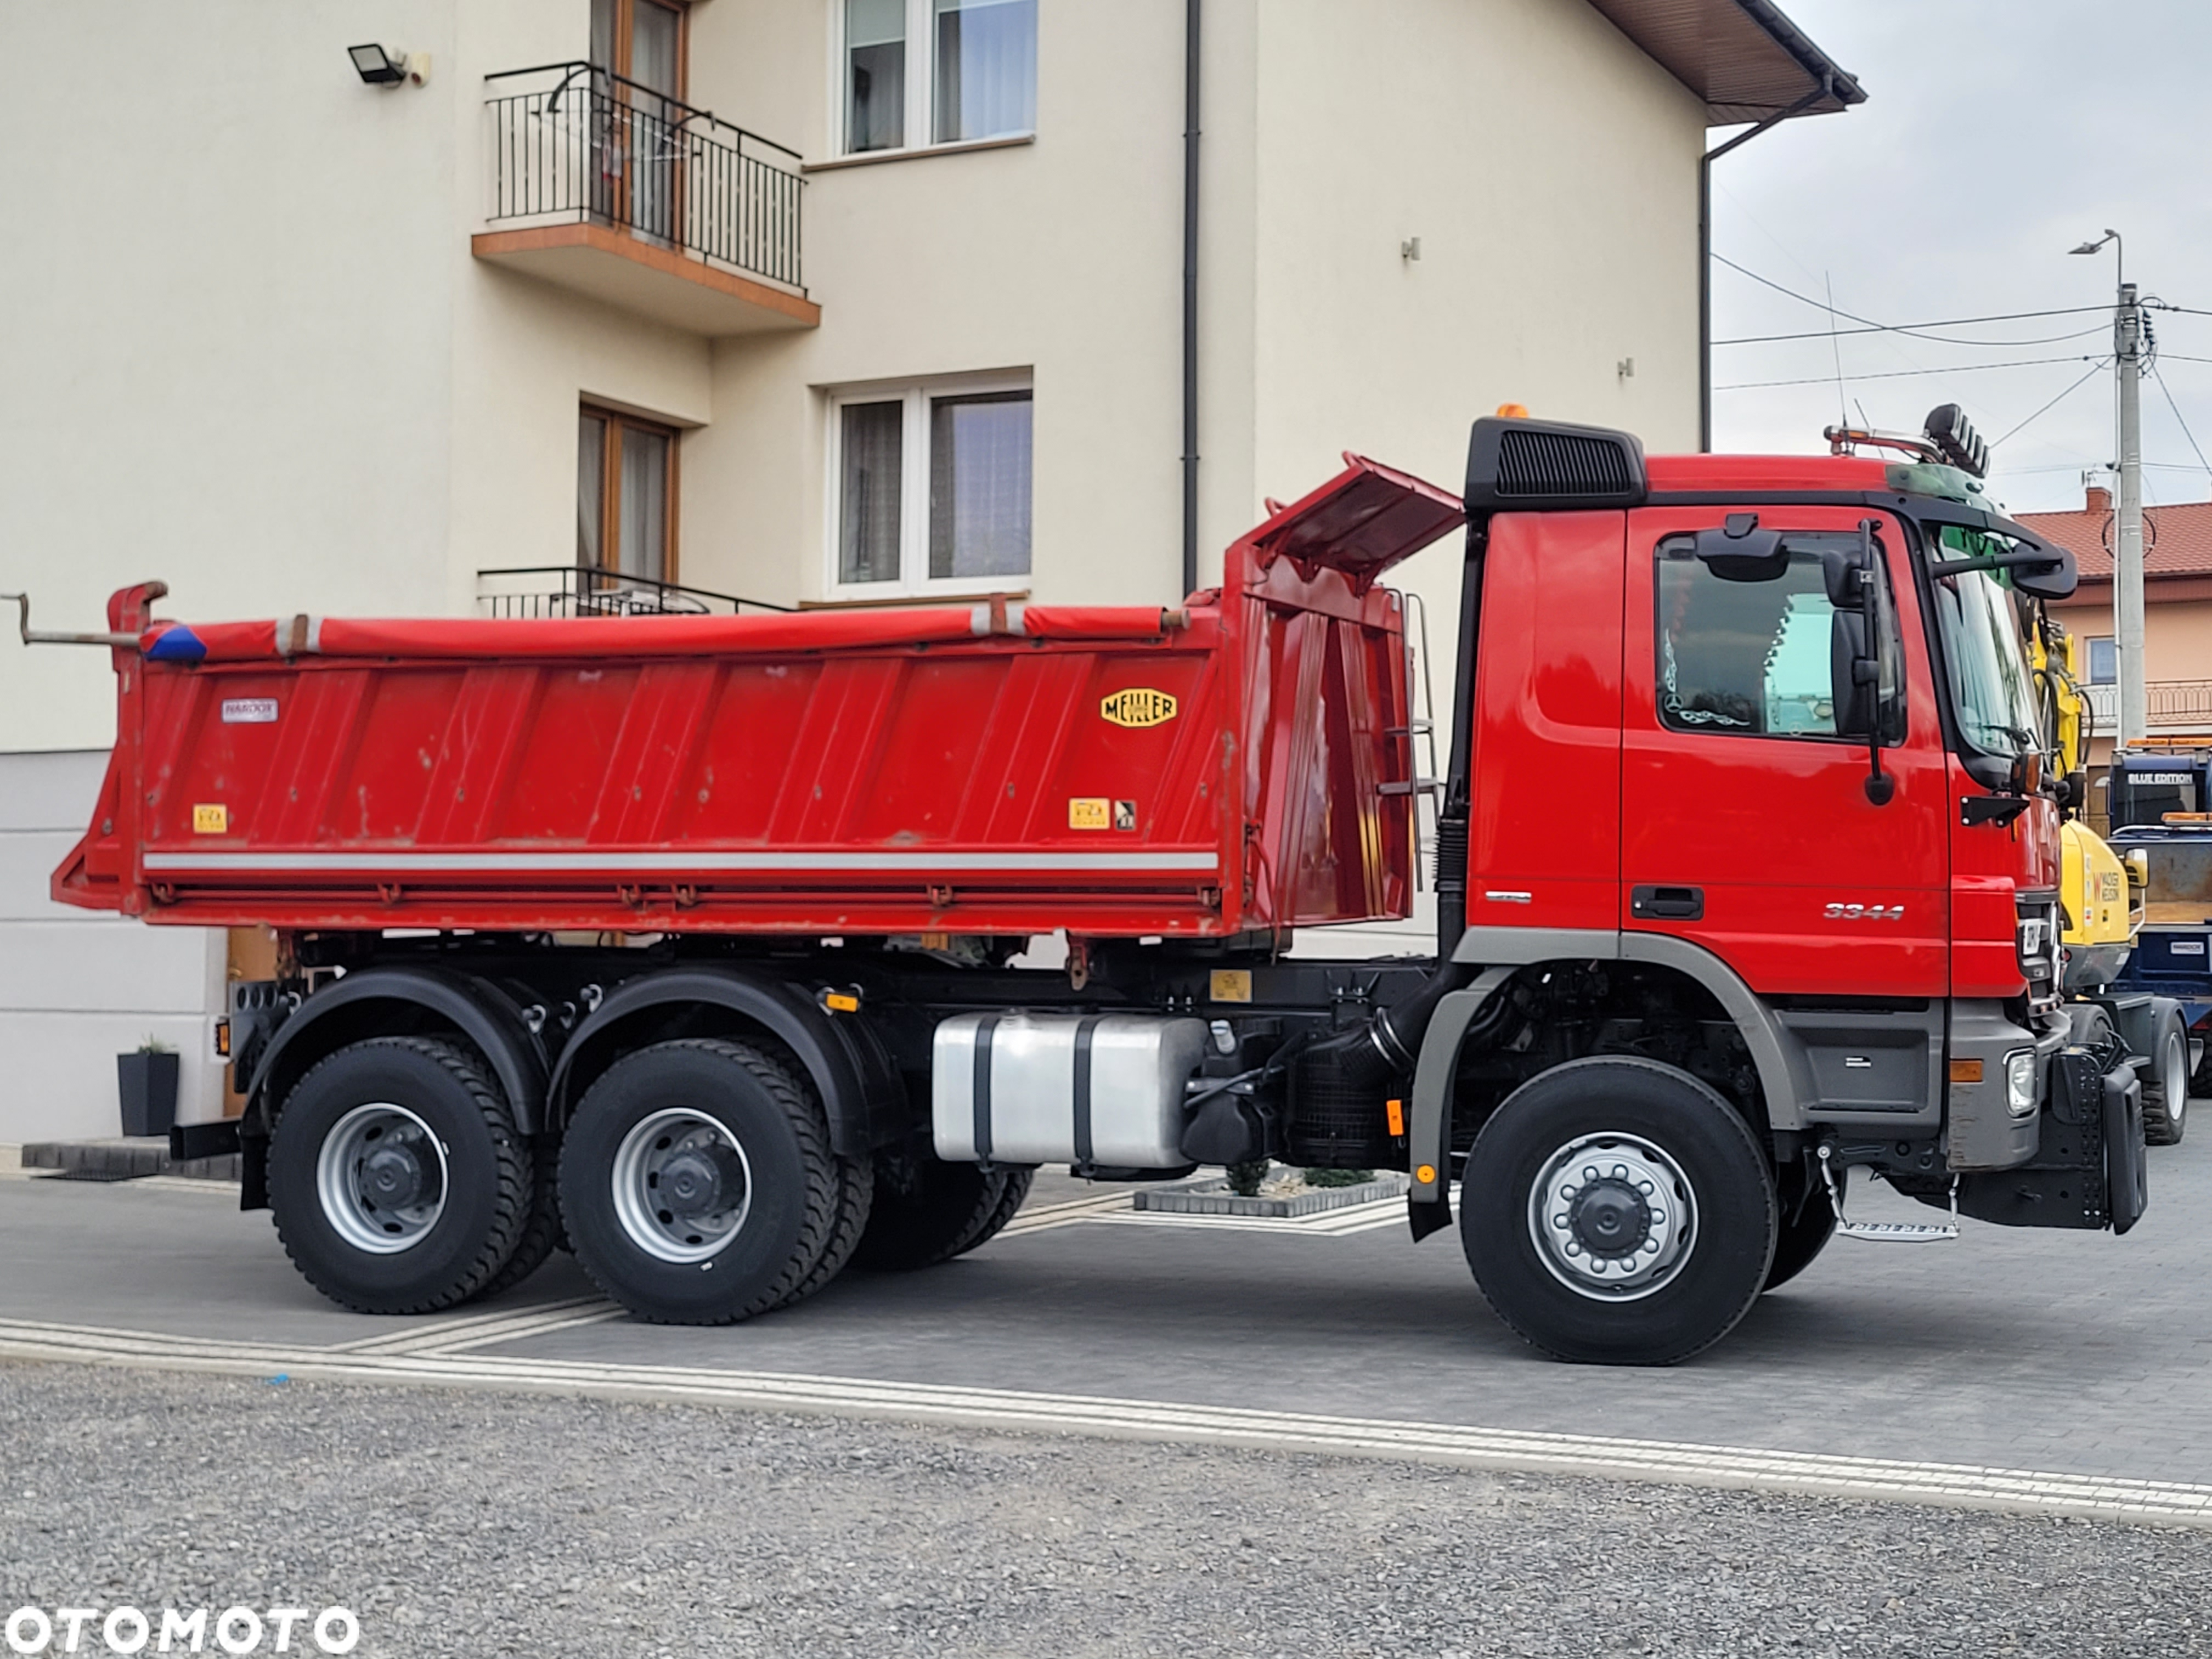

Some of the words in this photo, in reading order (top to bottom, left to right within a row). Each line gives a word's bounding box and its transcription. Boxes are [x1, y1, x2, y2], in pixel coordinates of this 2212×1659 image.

[1105, 693, 1172, 723] MEILLER
[2128, 773, 2153, 785] BLUE
[2154, 773, 2193, 785] EDITION
[1823, 902, 1905, 921] 3344
